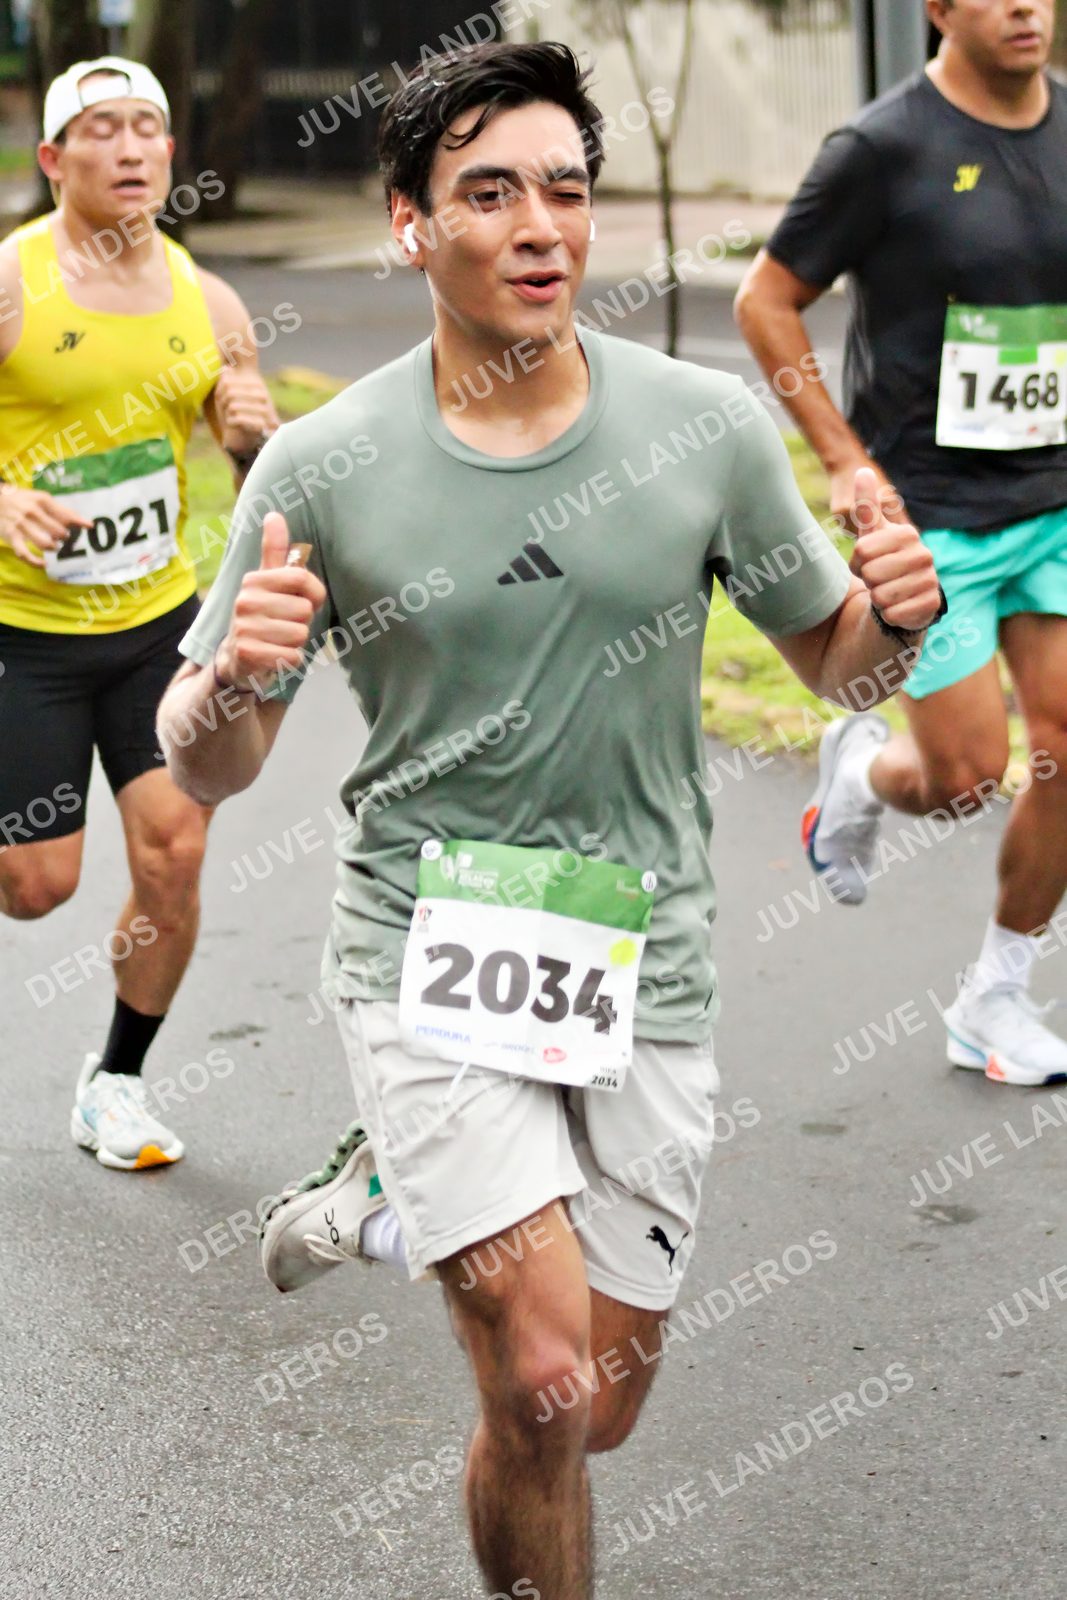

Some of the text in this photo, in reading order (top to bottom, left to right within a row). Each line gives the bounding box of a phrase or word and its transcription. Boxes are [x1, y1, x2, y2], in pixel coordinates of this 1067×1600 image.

[959, 371, 1060, 413] 1468
[56, 498, 169, 560] 2021
[421, 943, 618, 1035] 2034
[591, 1074, 618, 1089] 2034
